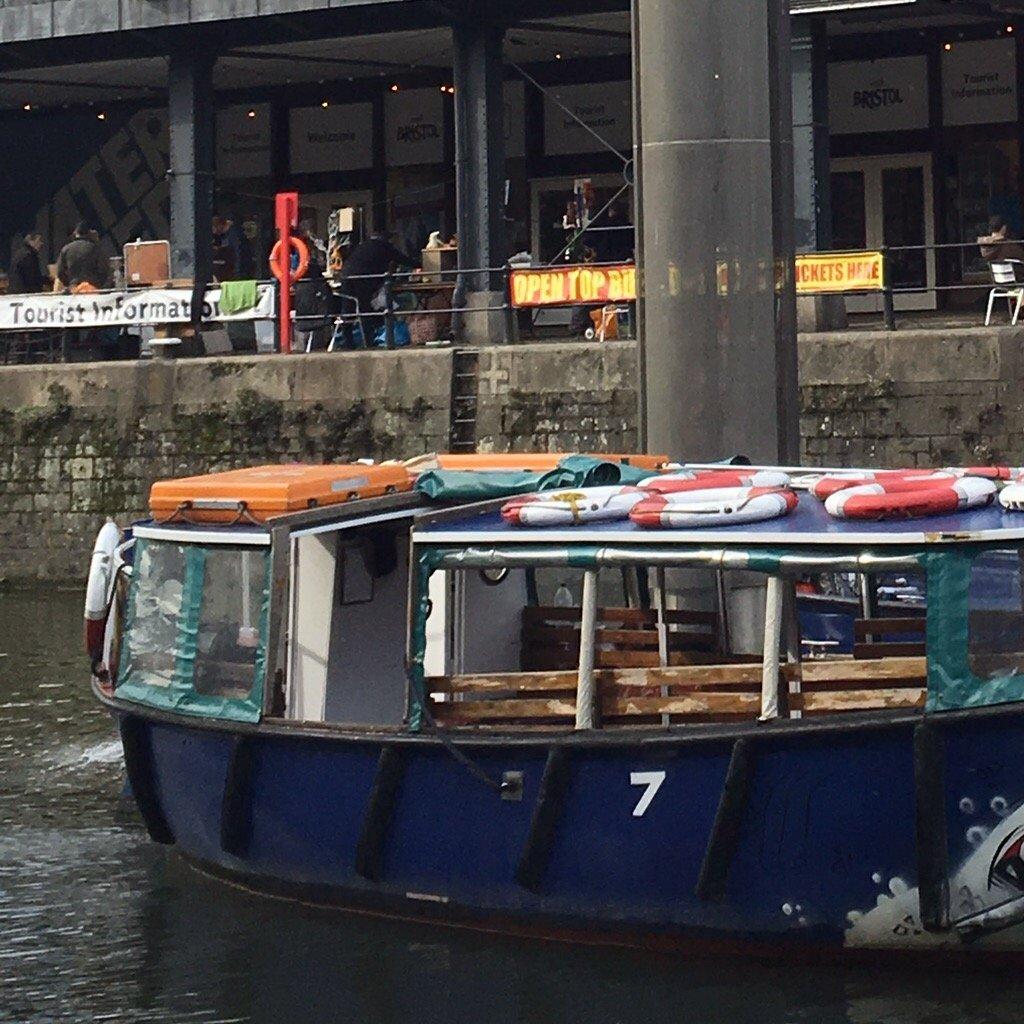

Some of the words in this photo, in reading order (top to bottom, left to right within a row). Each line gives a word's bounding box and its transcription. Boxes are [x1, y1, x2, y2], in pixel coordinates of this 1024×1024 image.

[852, 88, 904, 110] BRISTOL
[796, 262, 844, 283] ICKETS
[513, 271, 564, 305] OPEN
[567, 268, 606, 302] TOP
[607, 268, 637, 301] BU
[10, 301, 86, 325] Tourist
[630, 770, 666, 817] 7
